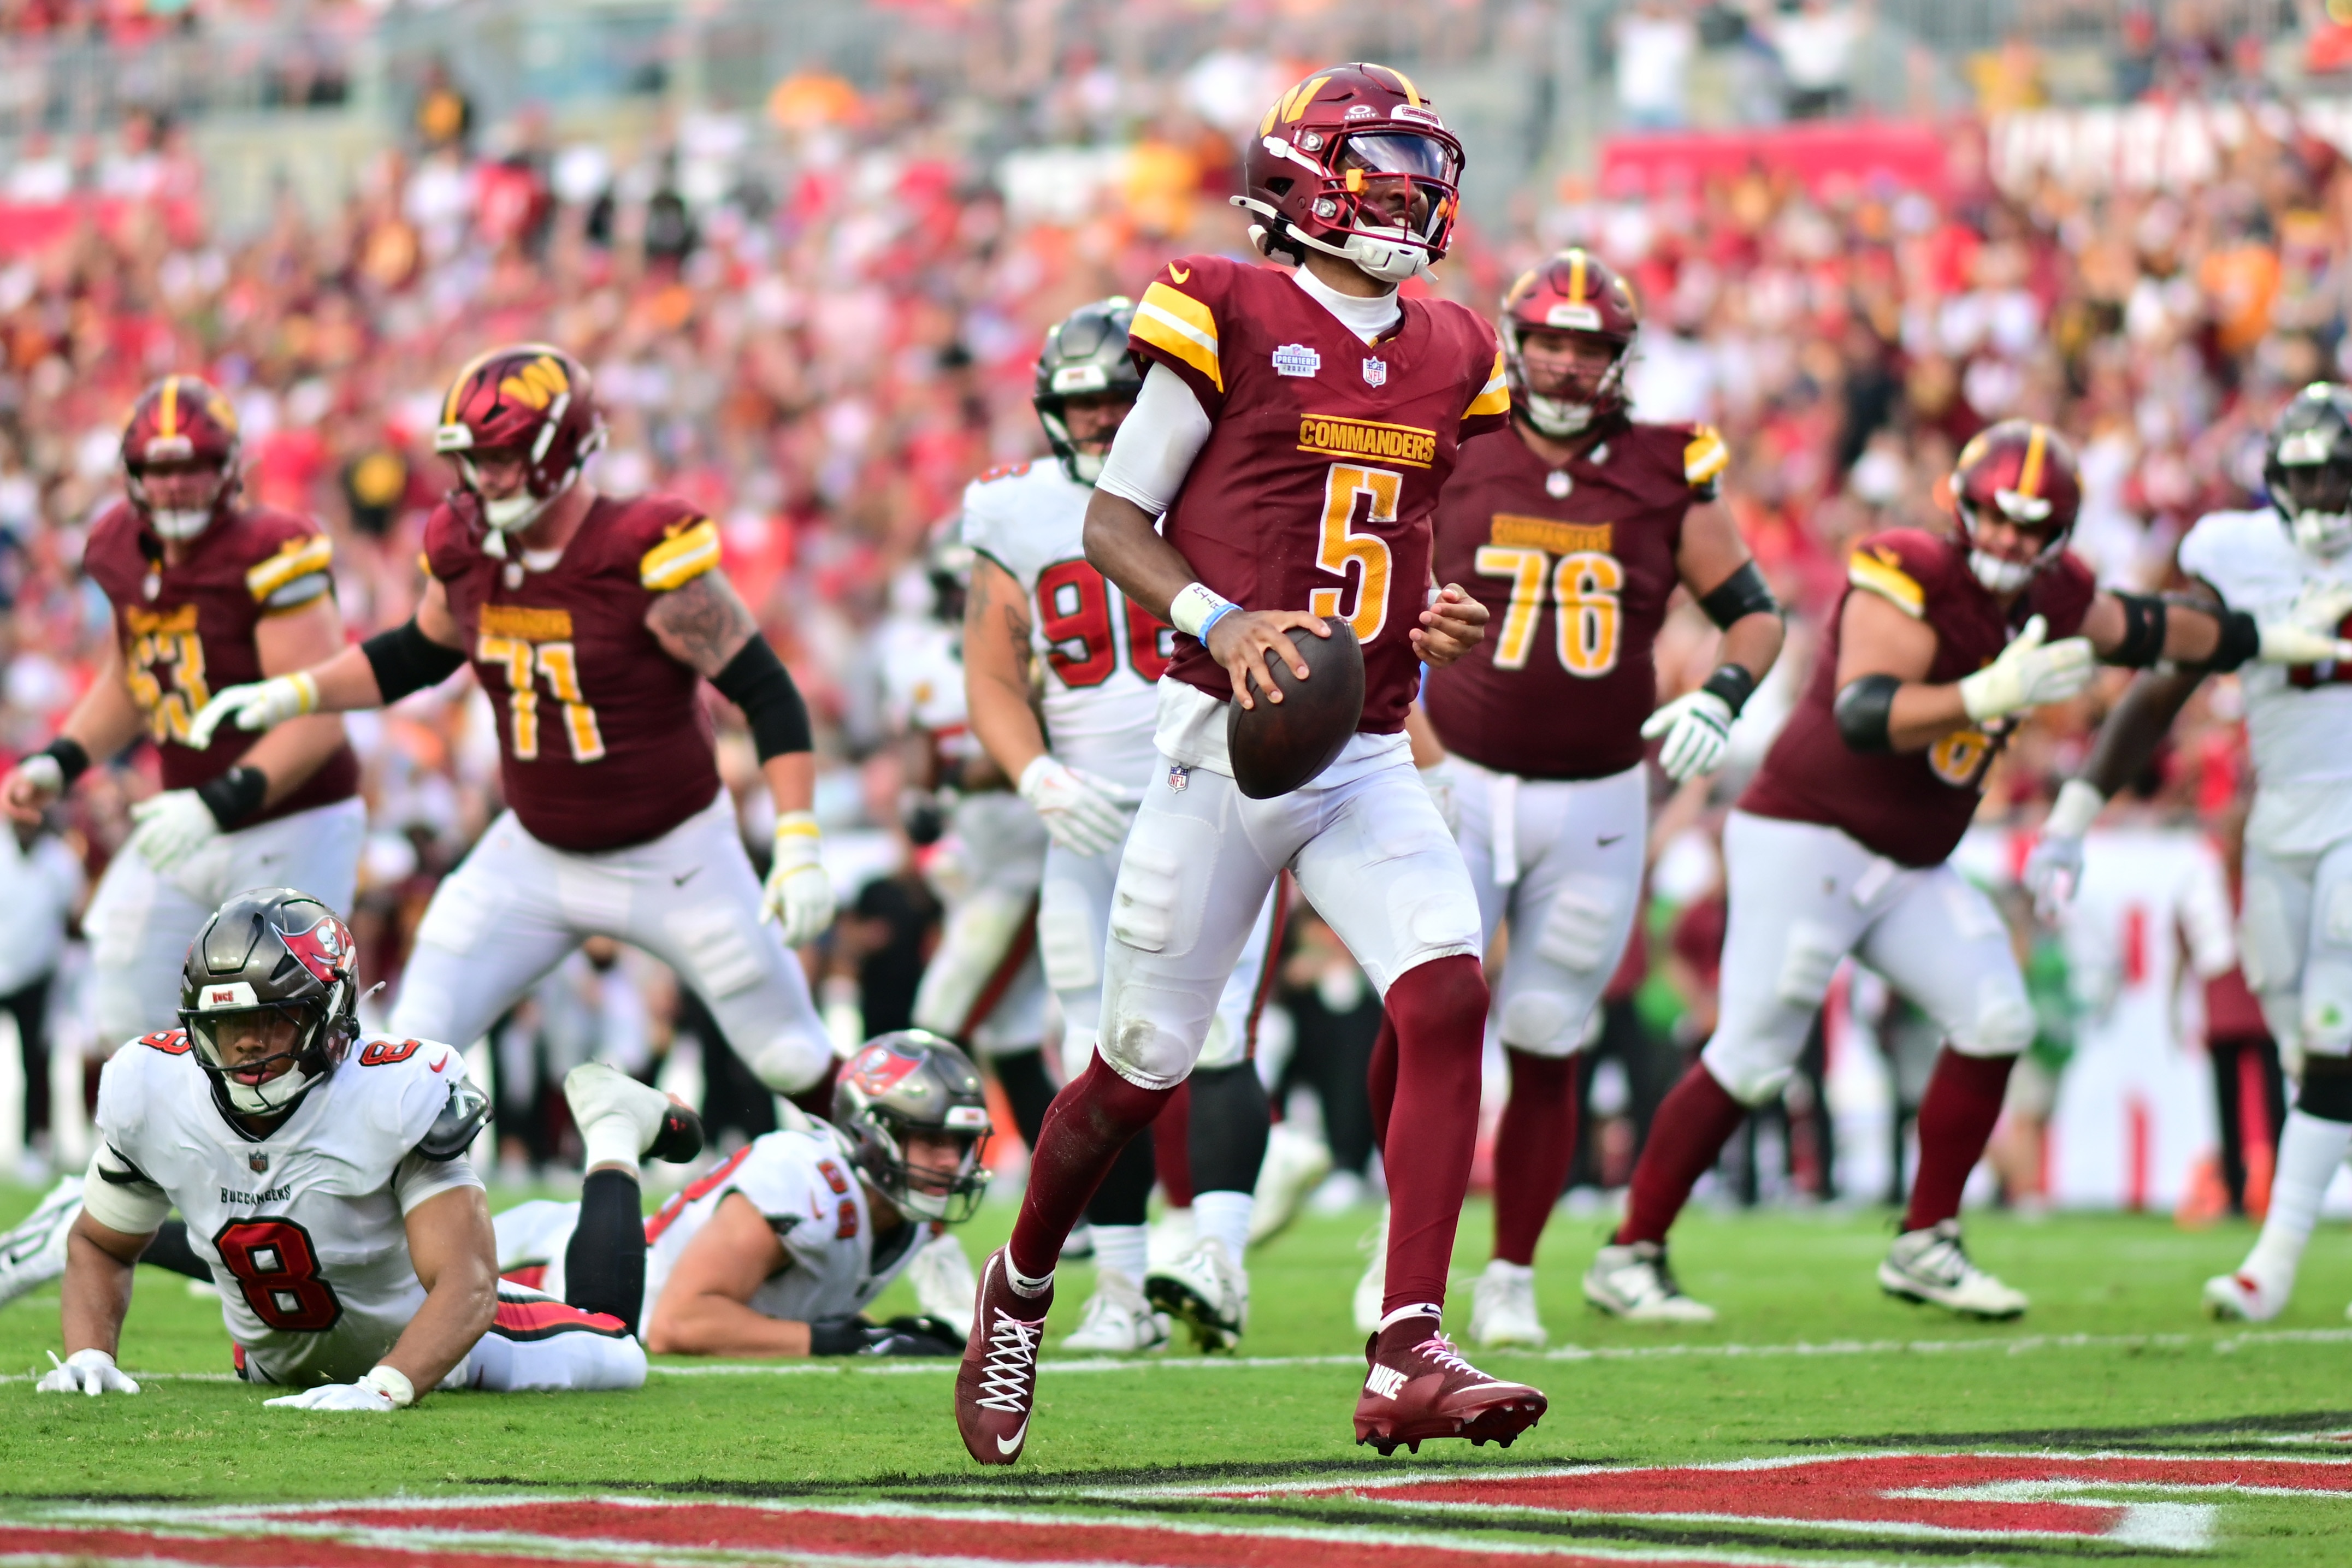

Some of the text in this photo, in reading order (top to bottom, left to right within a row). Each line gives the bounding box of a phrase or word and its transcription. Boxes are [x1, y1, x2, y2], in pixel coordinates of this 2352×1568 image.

[1368, 369, 1382, 382] NFL
[1299, 419, 1436, 463] COMMANDERS
[1309, 462, 1403, 645] 5
[1475, 546, 1624, 678] 76
[477, 635, 605, 762] 71
[1170, 774, 1184, 787] NFL
[252, 1159, 266, 1170] NFL
[220, 1184, 292, 1207] BUCCANEERS
[212, 1216, 344, 1332] 8
[1365, 1362, 1409, 1401] NIKE
